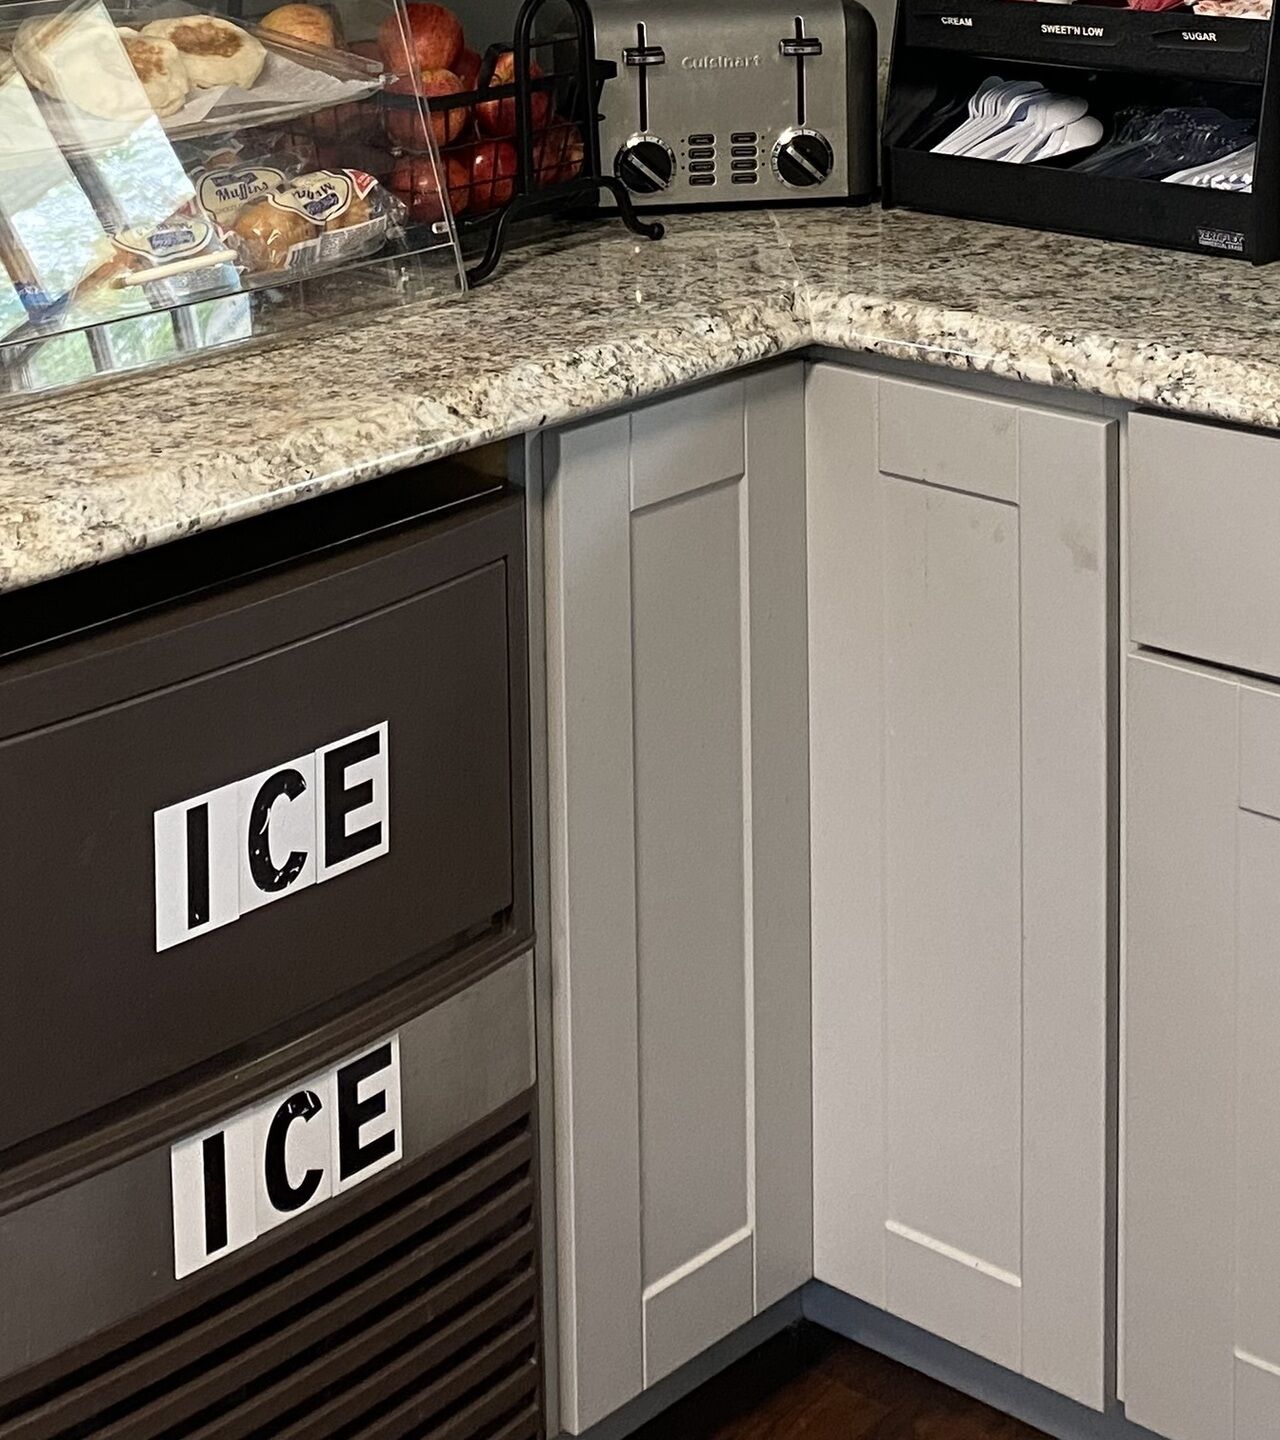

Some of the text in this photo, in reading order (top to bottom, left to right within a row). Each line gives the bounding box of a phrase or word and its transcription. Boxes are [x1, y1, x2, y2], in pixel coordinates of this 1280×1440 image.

[941, 16, 973, 27] CREAM
[1041, 24, 1104, 37] SWEET'N LOW
[1182, 31, 1217, 42] SUGAR
[681, 54, 761, 70] Cuisinart
[215, 182, 269, 202] Muffins
[186, 731, 383, 931] ICE
[202, 1042, 396, 1257] ICE
